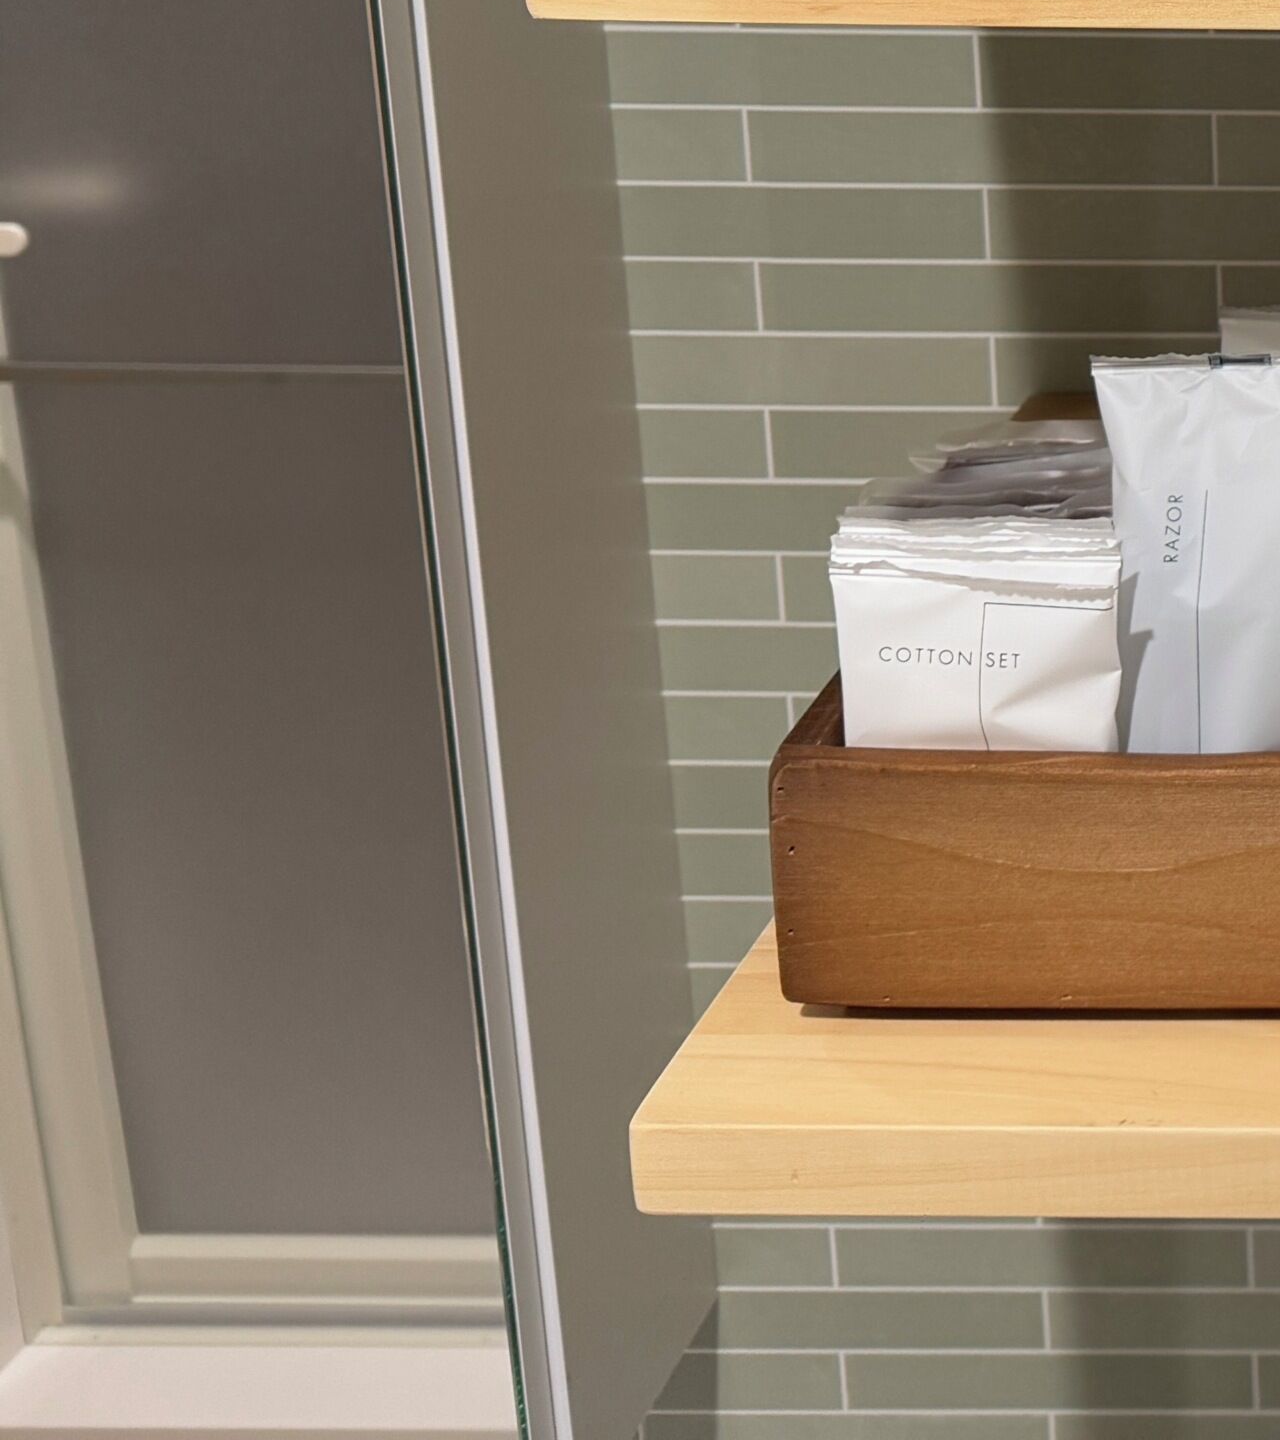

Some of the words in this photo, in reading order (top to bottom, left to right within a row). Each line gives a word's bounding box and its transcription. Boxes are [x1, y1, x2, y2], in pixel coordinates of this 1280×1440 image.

[1163, 493, 1184, 563] RAZOR
[878, 646, 973, 666] COTTON
[985, 651, 1021, 669] SET
